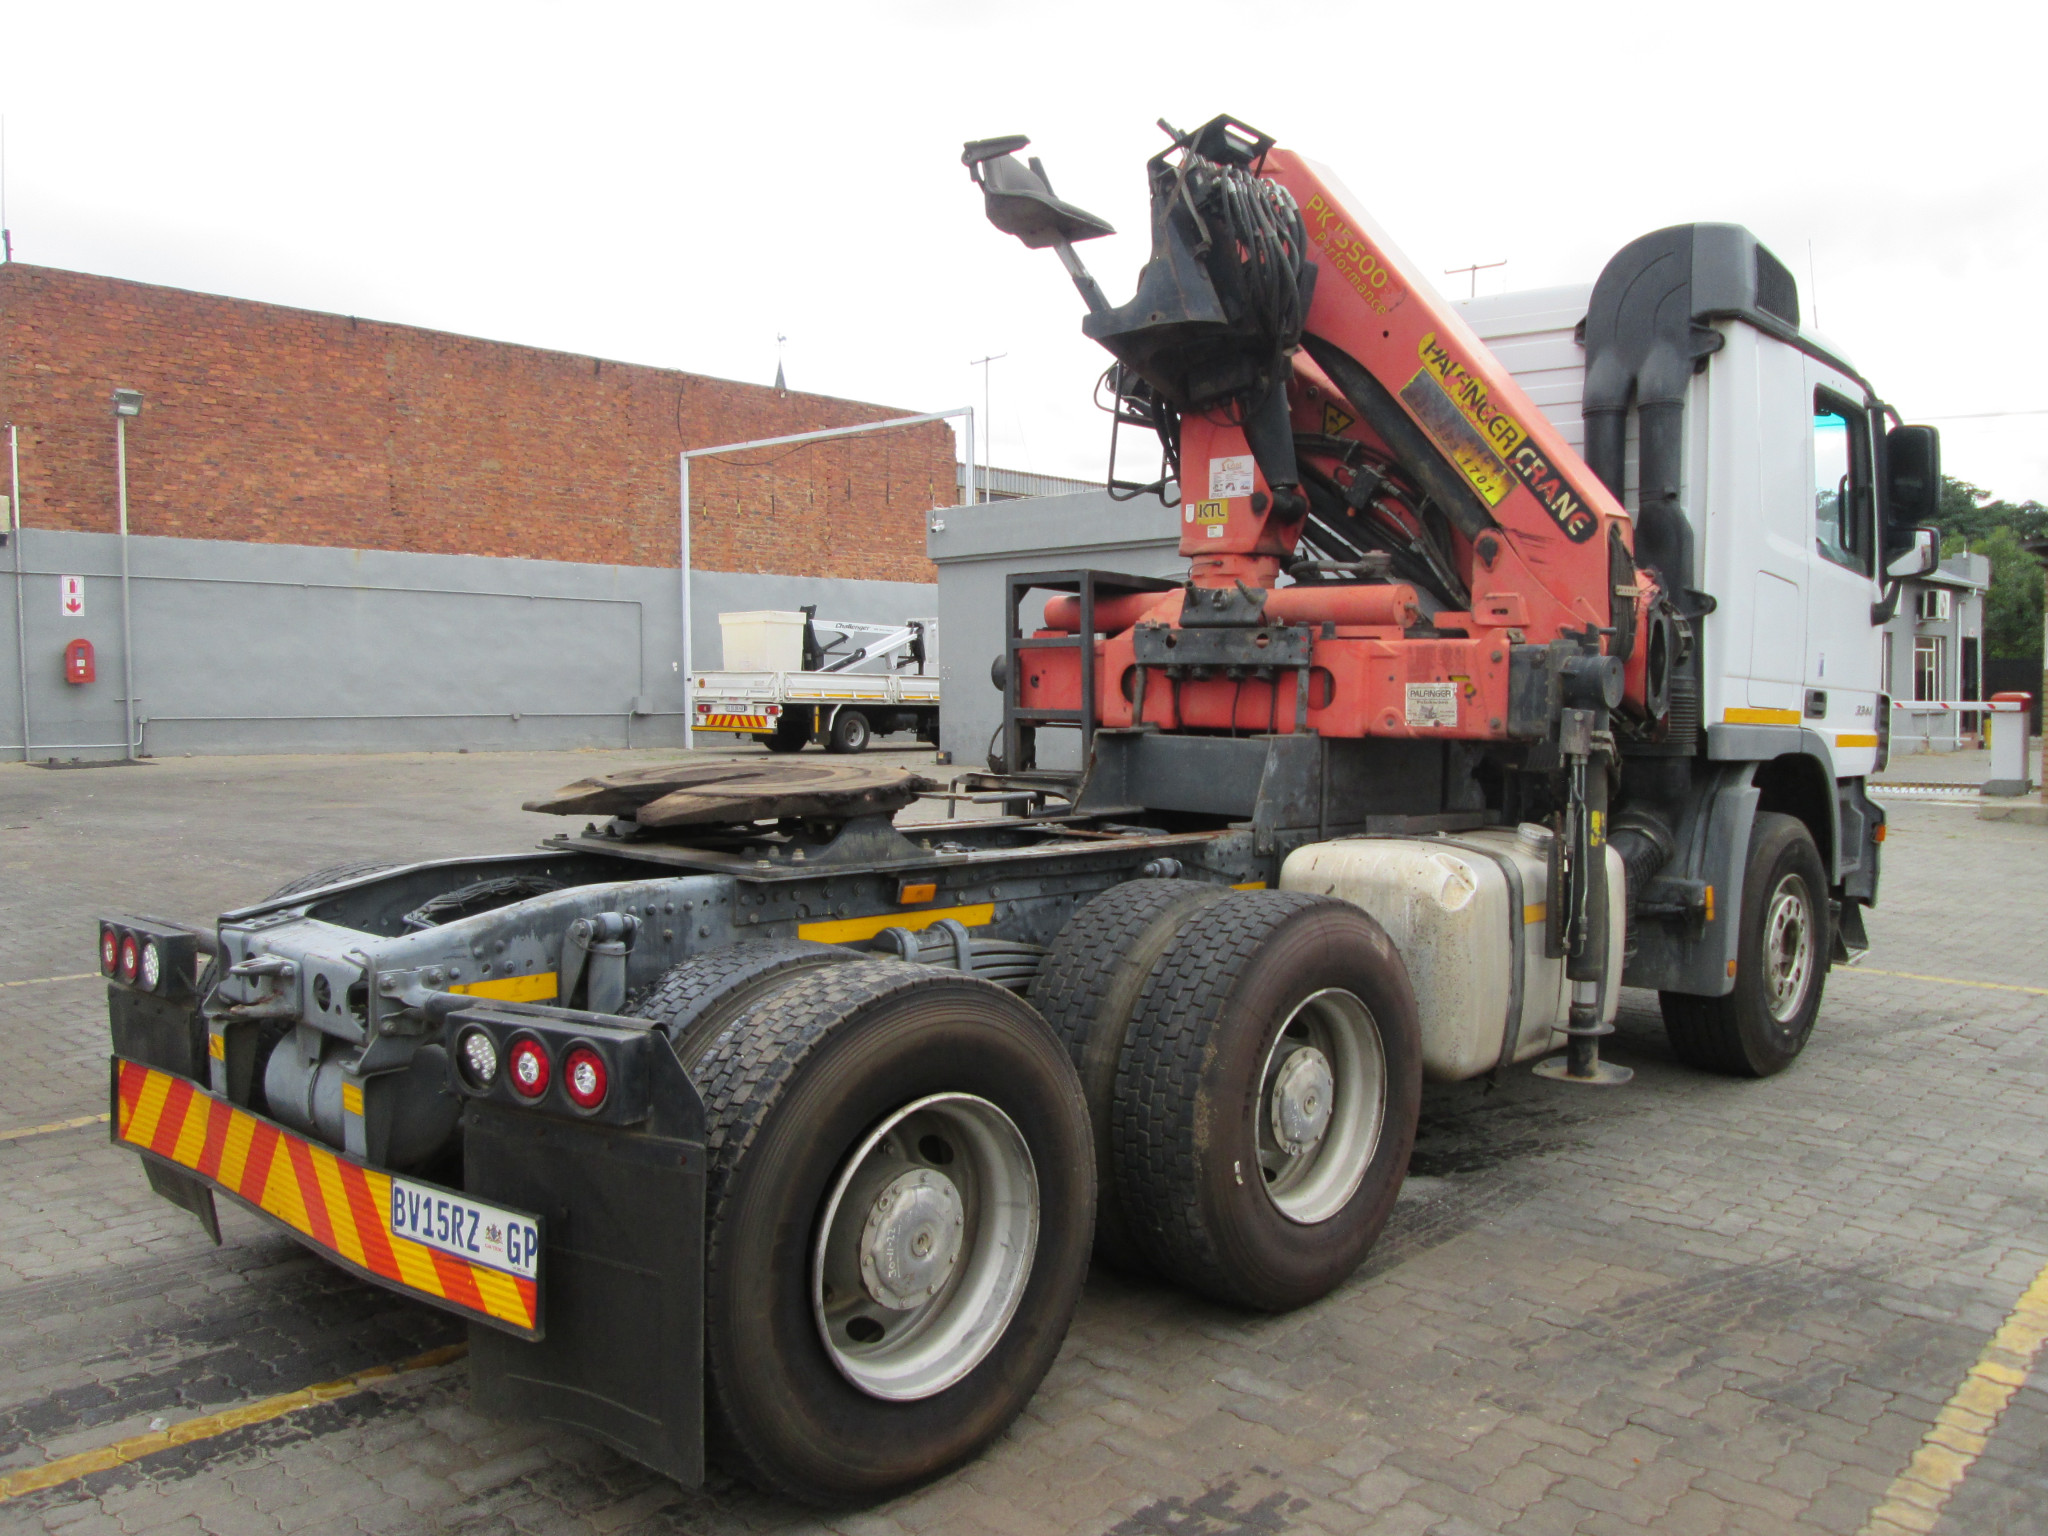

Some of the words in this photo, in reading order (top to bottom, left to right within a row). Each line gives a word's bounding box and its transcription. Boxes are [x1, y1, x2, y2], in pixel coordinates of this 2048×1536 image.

[1305, 193, 1335, 229] PK
[1314, 231, 1387, 315] Performance
[1509, 447, 1592, 537] CRANE
[394, 1186, 481, 1254] BV15RZ
[507, 1221, 538, 1269] GP
